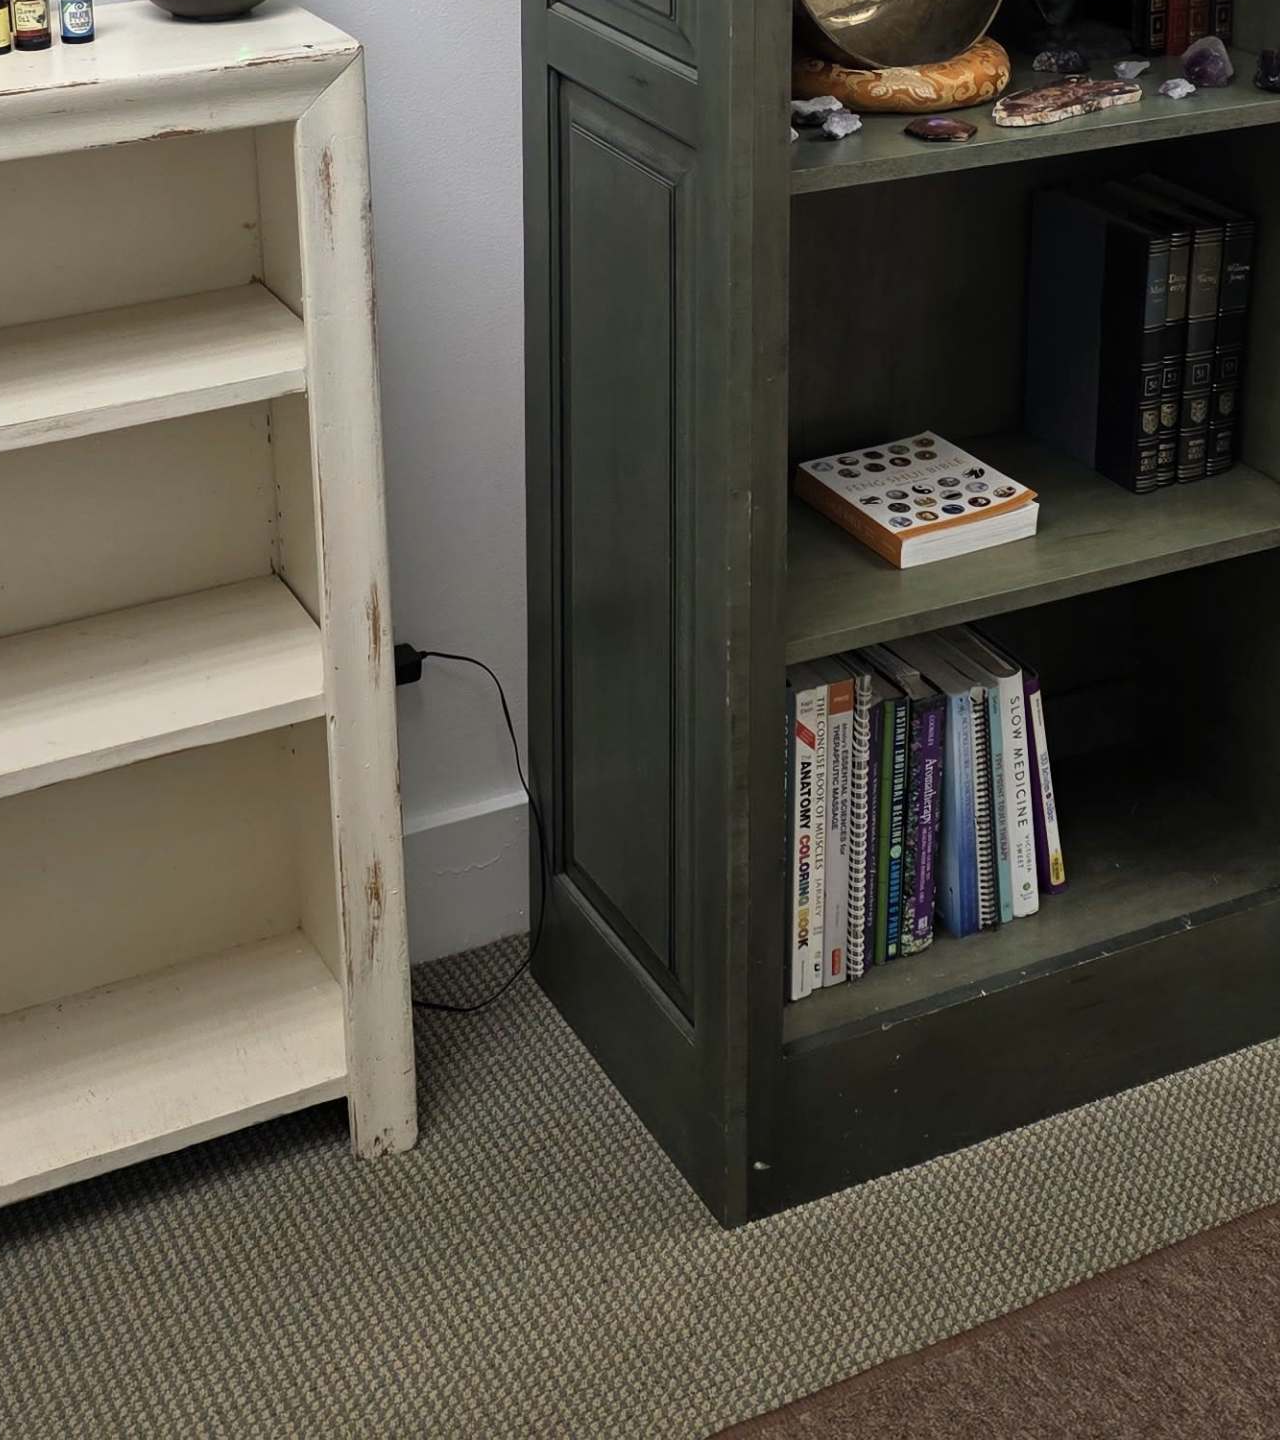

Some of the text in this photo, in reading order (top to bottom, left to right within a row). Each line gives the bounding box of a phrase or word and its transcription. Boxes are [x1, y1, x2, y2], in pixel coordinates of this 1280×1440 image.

[886, 470, 922, 483] SHUI
[925, 457, 965, 473] BIBLE
[816, 720, 825, 770] CONCISE
[895, 705, 906, 746] INSTANT
[831, 724, 840, 832] THERAPEUTIC MASSAGE
[841, 749, 850, 797] ESSENTIAL
[893, 749, 905, 802] EMOTIONAL
[1010, 696, 1028, 829] SLOW MEDICINE
[816, 772, 825, 802] BOOK
[919, 758, 938, 825] Aromatherapy
[815, 805, 824, 818] OF
[840, 798, 849, 842] SCIENCES
[890, 804, 903, 844] HEALING
[798, 760, 812, 950] ANATOMY COLORING BOOK
[815, 822, 824, 871] MUSCLES
[1016, 844, 1024, 869] SWEET
